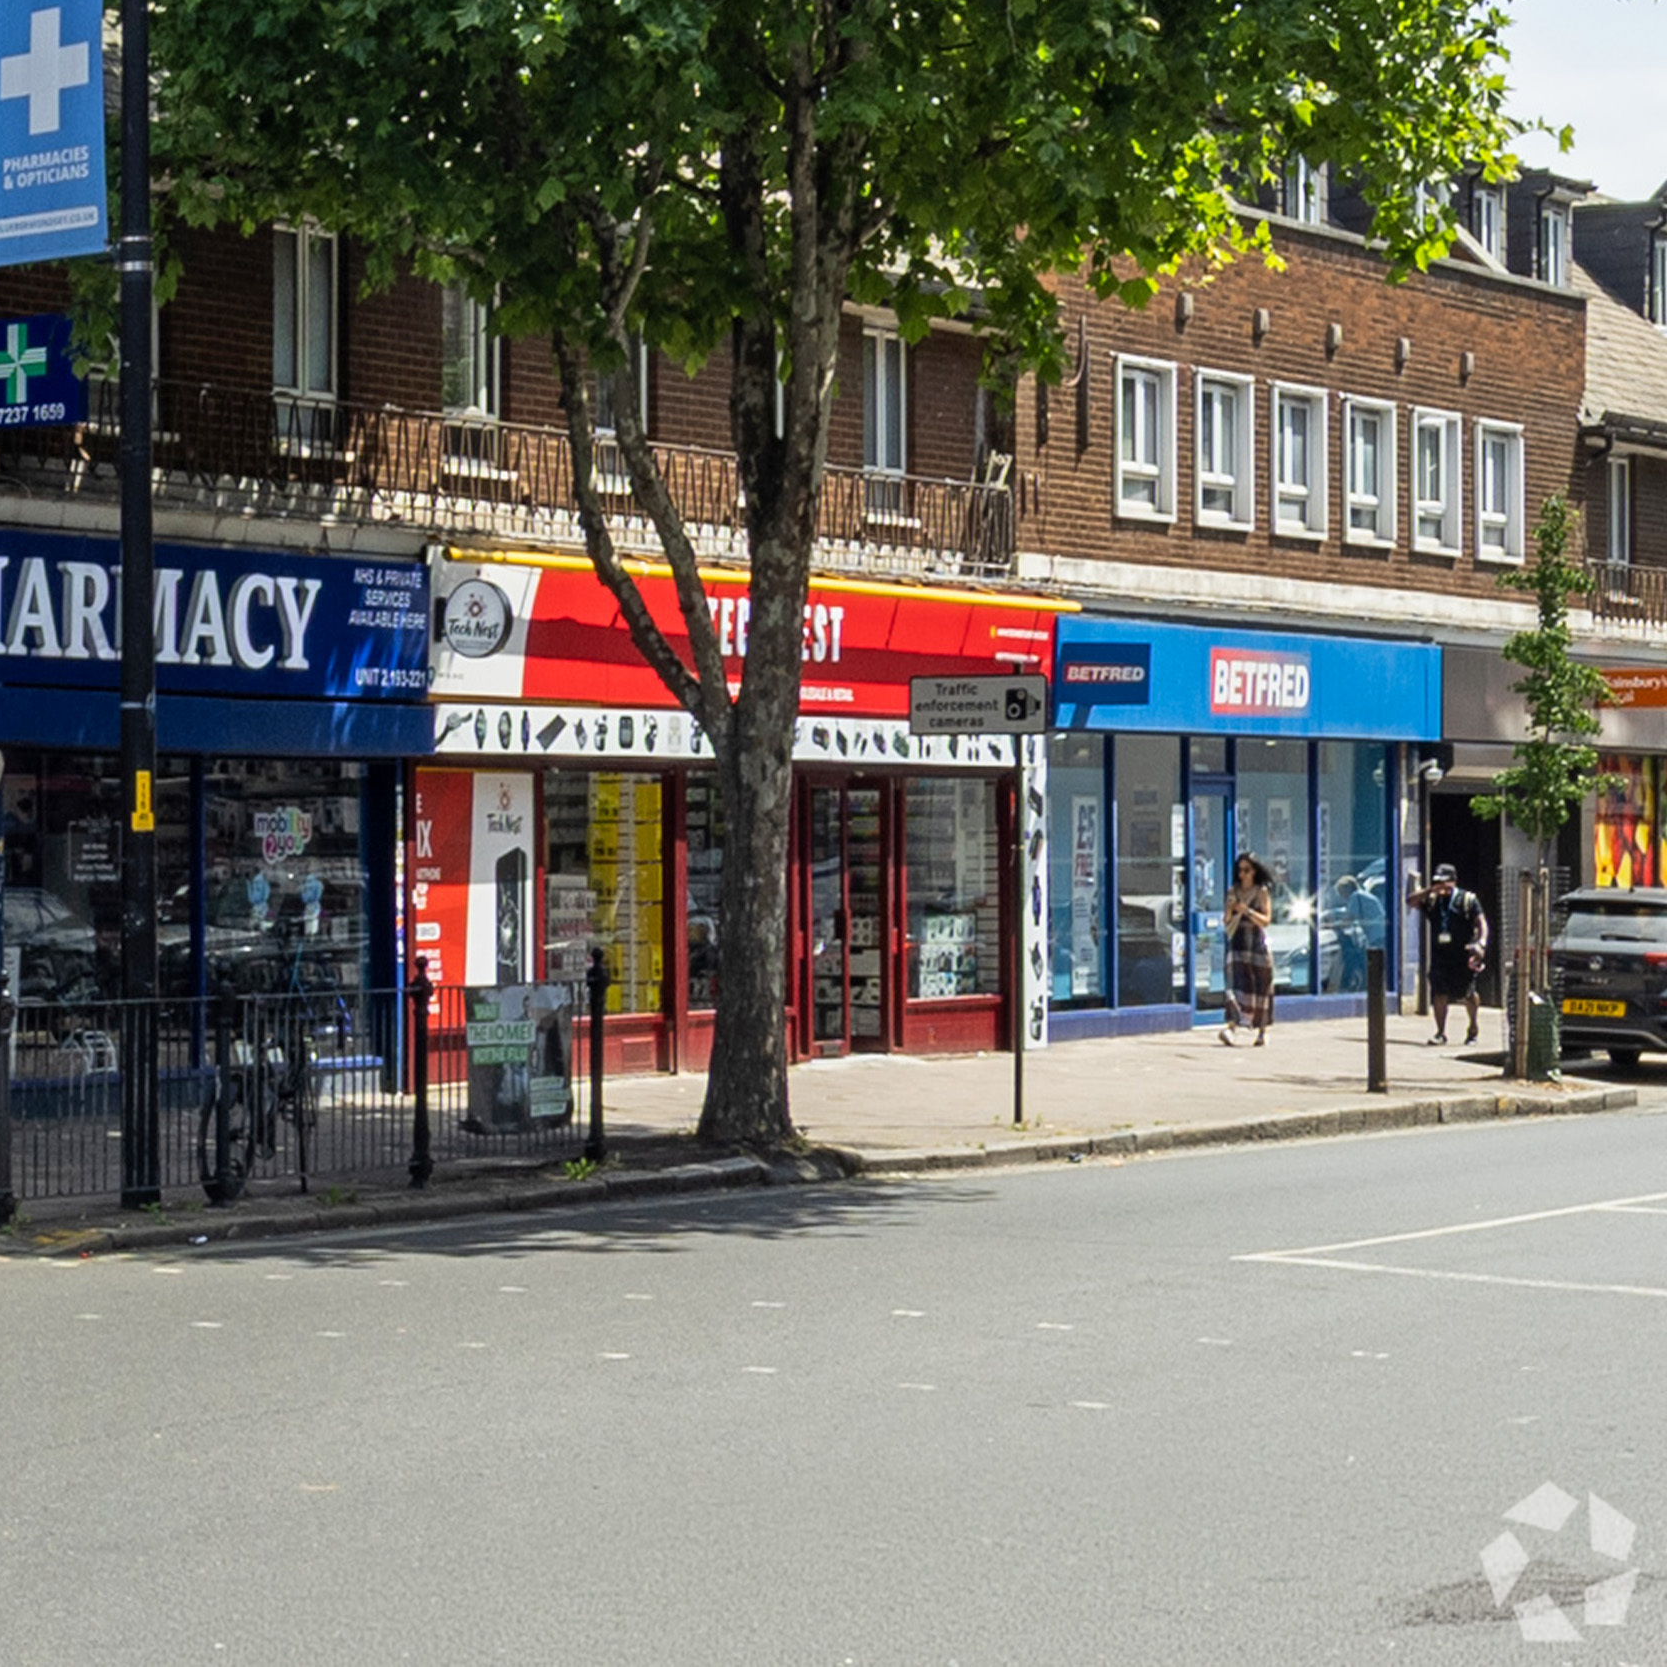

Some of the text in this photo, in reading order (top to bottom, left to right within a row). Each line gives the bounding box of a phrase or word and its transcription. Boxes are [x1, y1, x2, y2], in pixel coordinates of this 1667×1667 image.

[3, 145, 89, 173] PHARMACIES
[3, 163, 89, 190] & OPTICIANS
[32, 403, 65, 421] 1659
[354, 568, 423, 588] NHS & PRIVATE
[365, 589, 411, 608] SERVICES
[348, 610, 426, 629] AVAILABLE HERE
[448, 618, 500, 639] Tech Nest
[354, 667, 378, 685] UNIT
[1067, 665, 1145, 682] BETFRED
[935, 683, 978, 696] Traffic
[1214, 659, 1310, 708] BETFRED
[915, 699, 999, 714] enforcement
[929, 717, 984, 729] cameras
